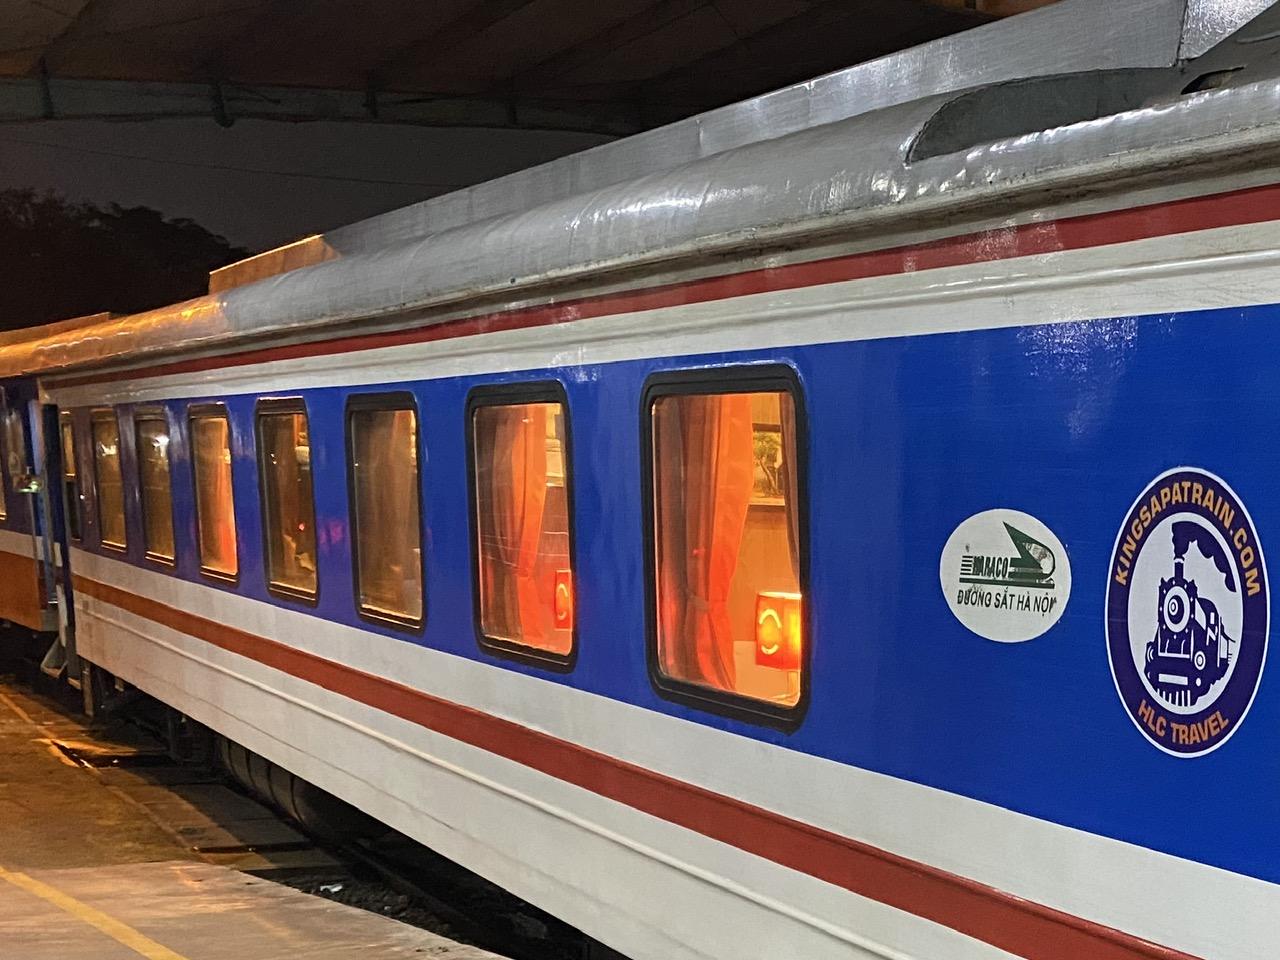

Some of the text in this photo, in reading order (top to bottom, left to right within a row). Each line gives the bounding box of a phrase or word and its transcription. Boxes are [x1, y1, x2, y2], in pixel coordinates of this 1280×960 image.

[1115, 481, 1261, 596] KINGSAPATRAIN.COM
[994, 586, 1015, 610] SẮT
[1016, 591, 1031, 612] HÀ
[1138, 699, 1229, 745] HLC TRAVEL
